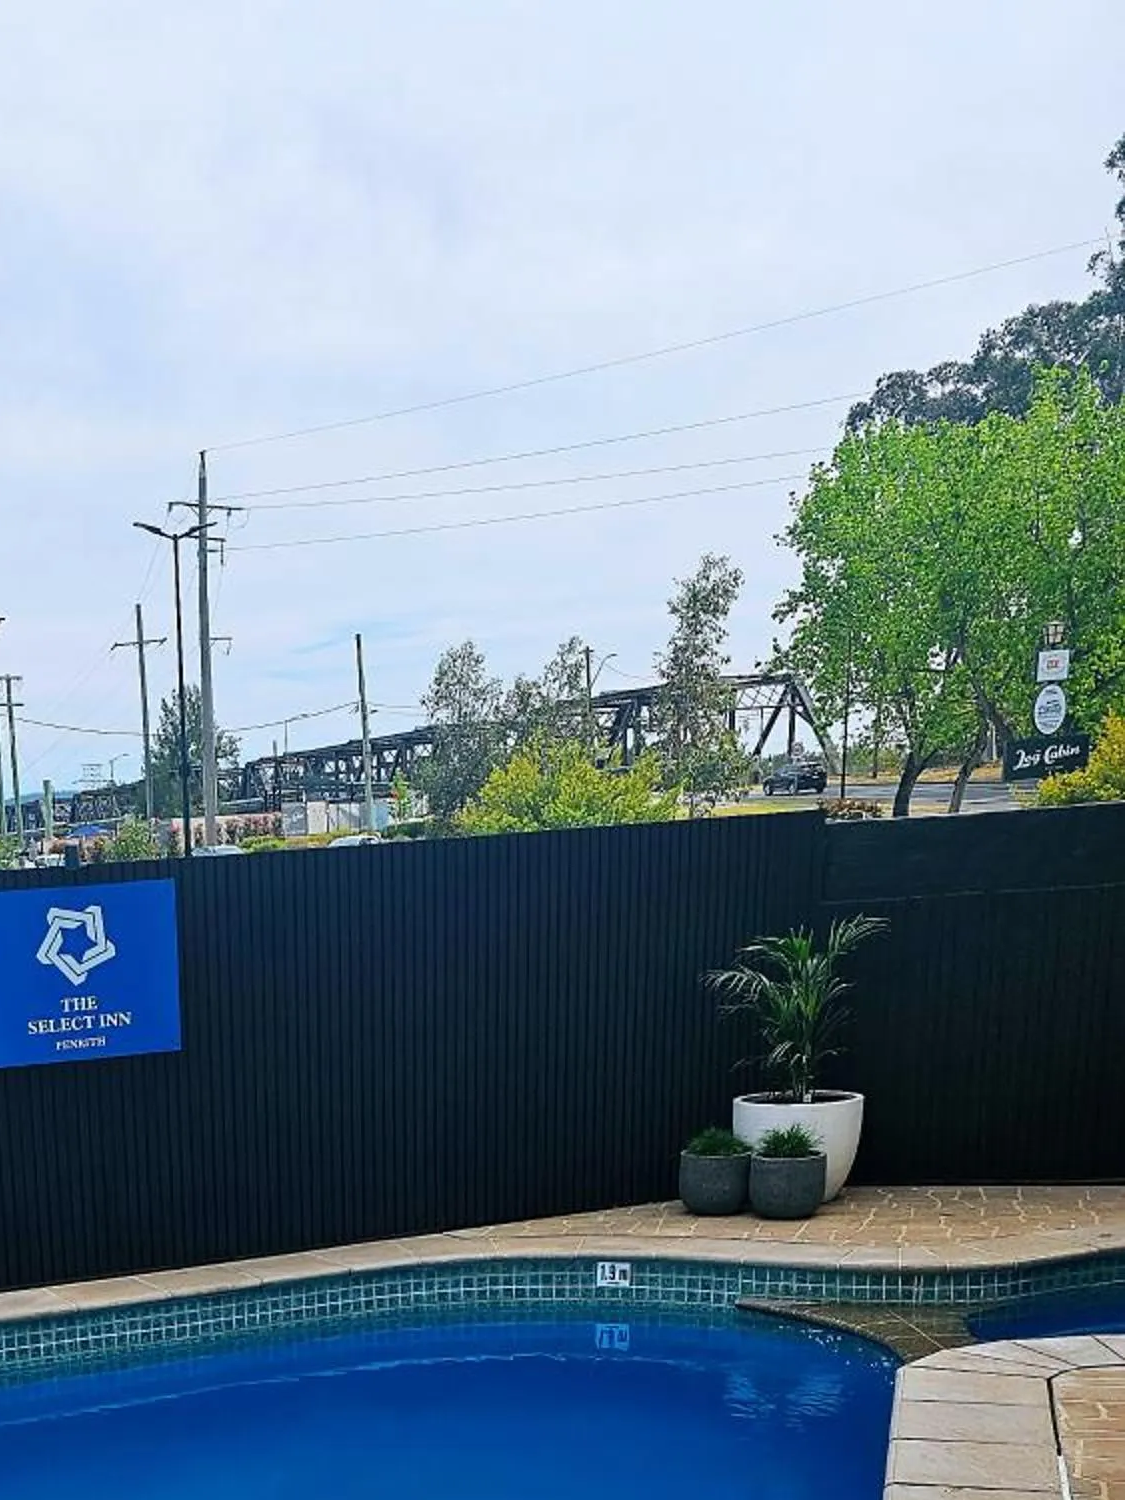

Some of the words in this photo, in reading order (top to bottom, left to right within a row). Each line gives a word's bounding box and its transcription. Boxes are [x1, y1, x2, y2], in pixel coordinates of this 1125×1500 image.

[60, 996, 98, 1012] THE
[28, 1015, 95, 1035] SELECT
[99, 1012, 132, 1028] INN
